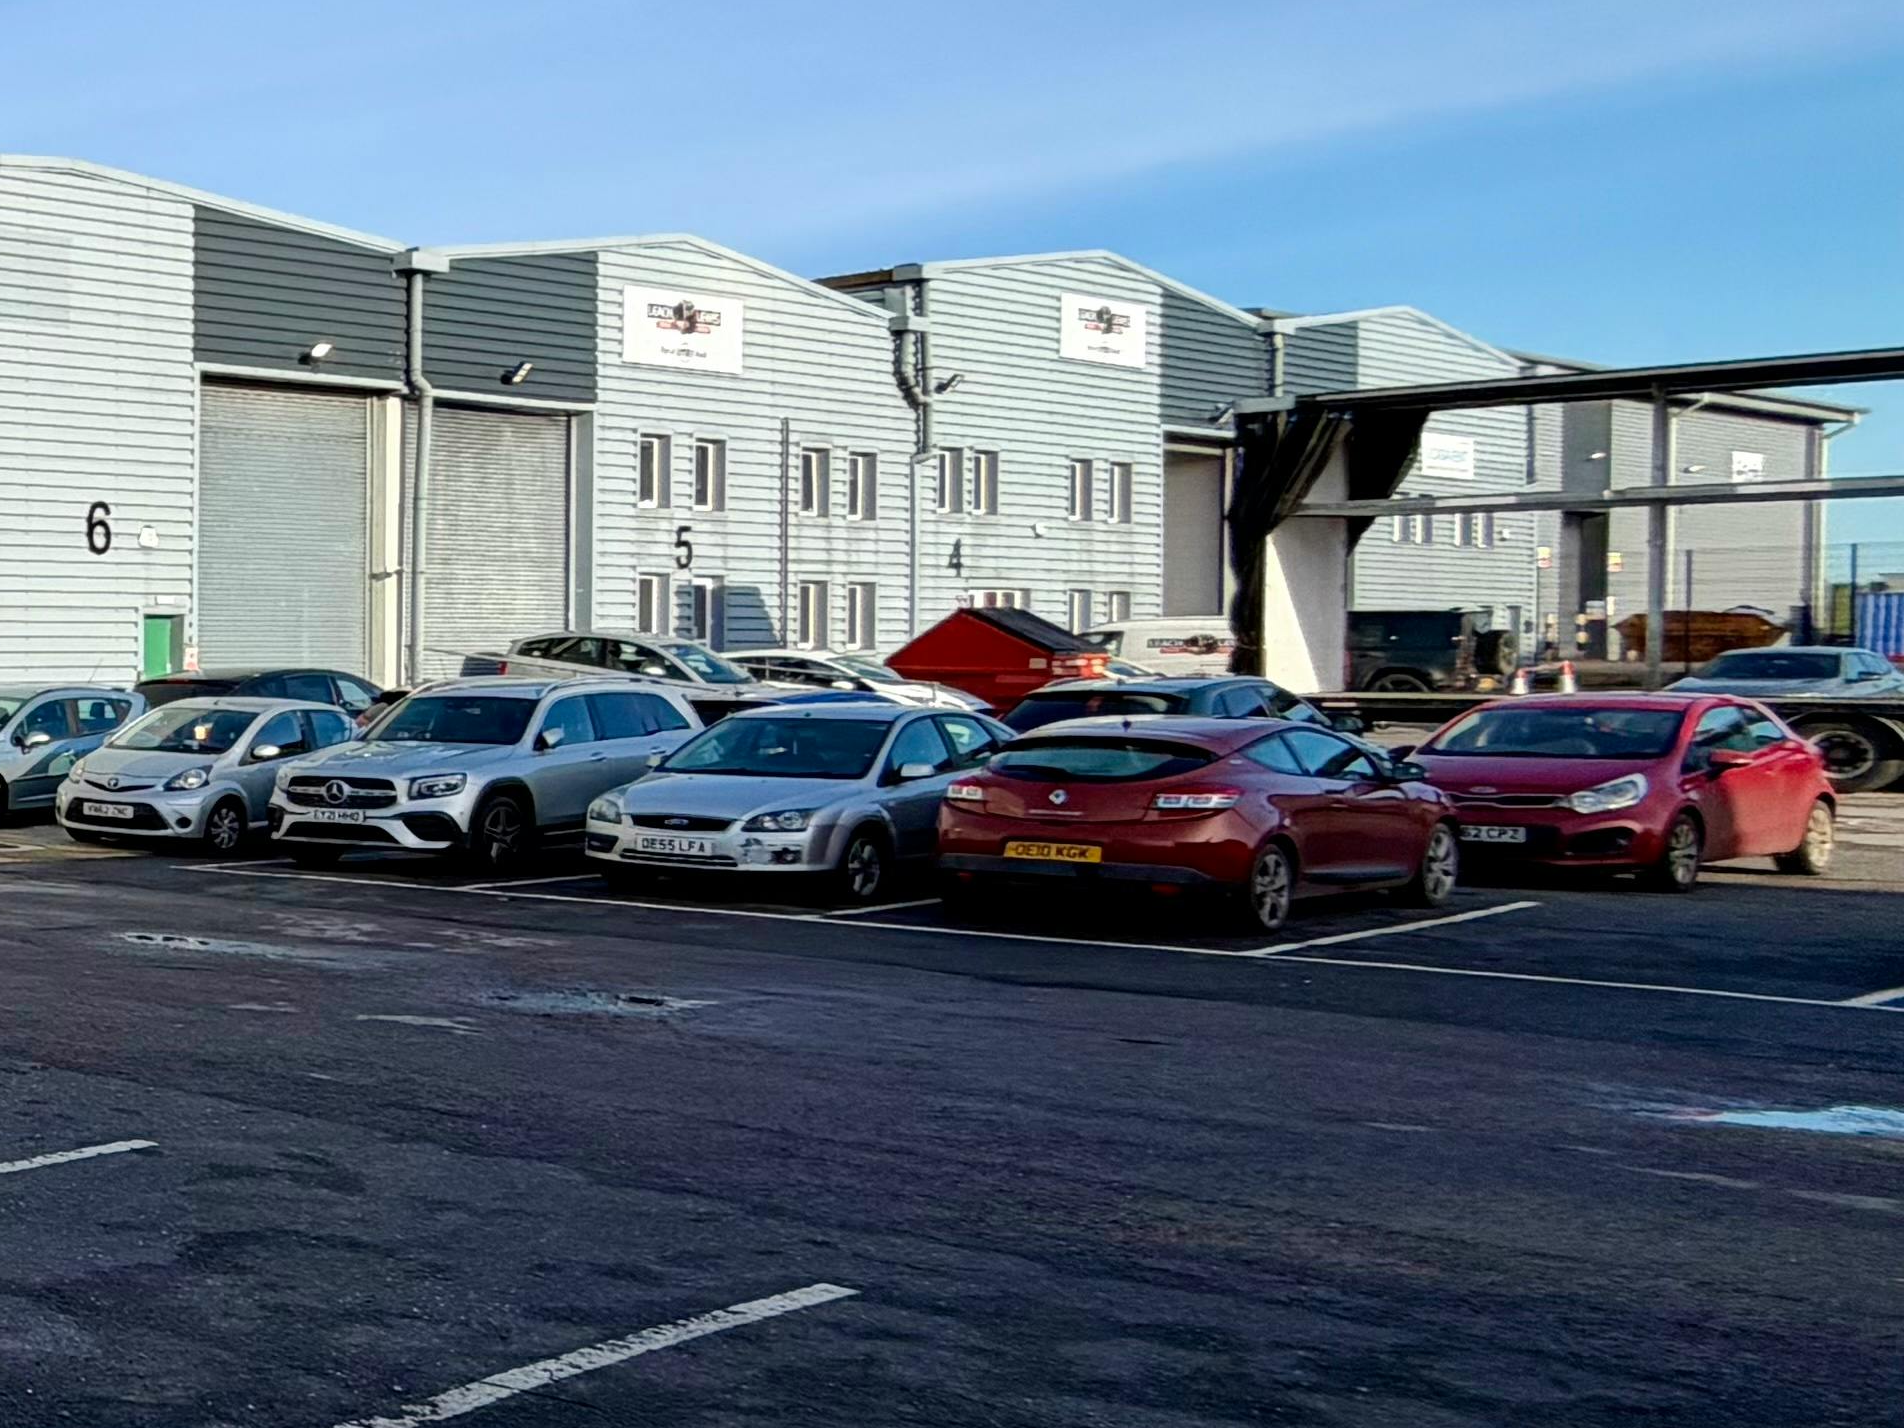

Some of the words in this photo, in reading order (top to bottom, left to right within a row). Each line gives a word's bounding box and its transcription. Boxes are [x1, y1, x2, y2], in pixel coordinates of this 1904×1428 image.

[87, 501, 111, 555] 6
[674, 525, 693, 569] 5
[947, 538, 964, 577] 4
